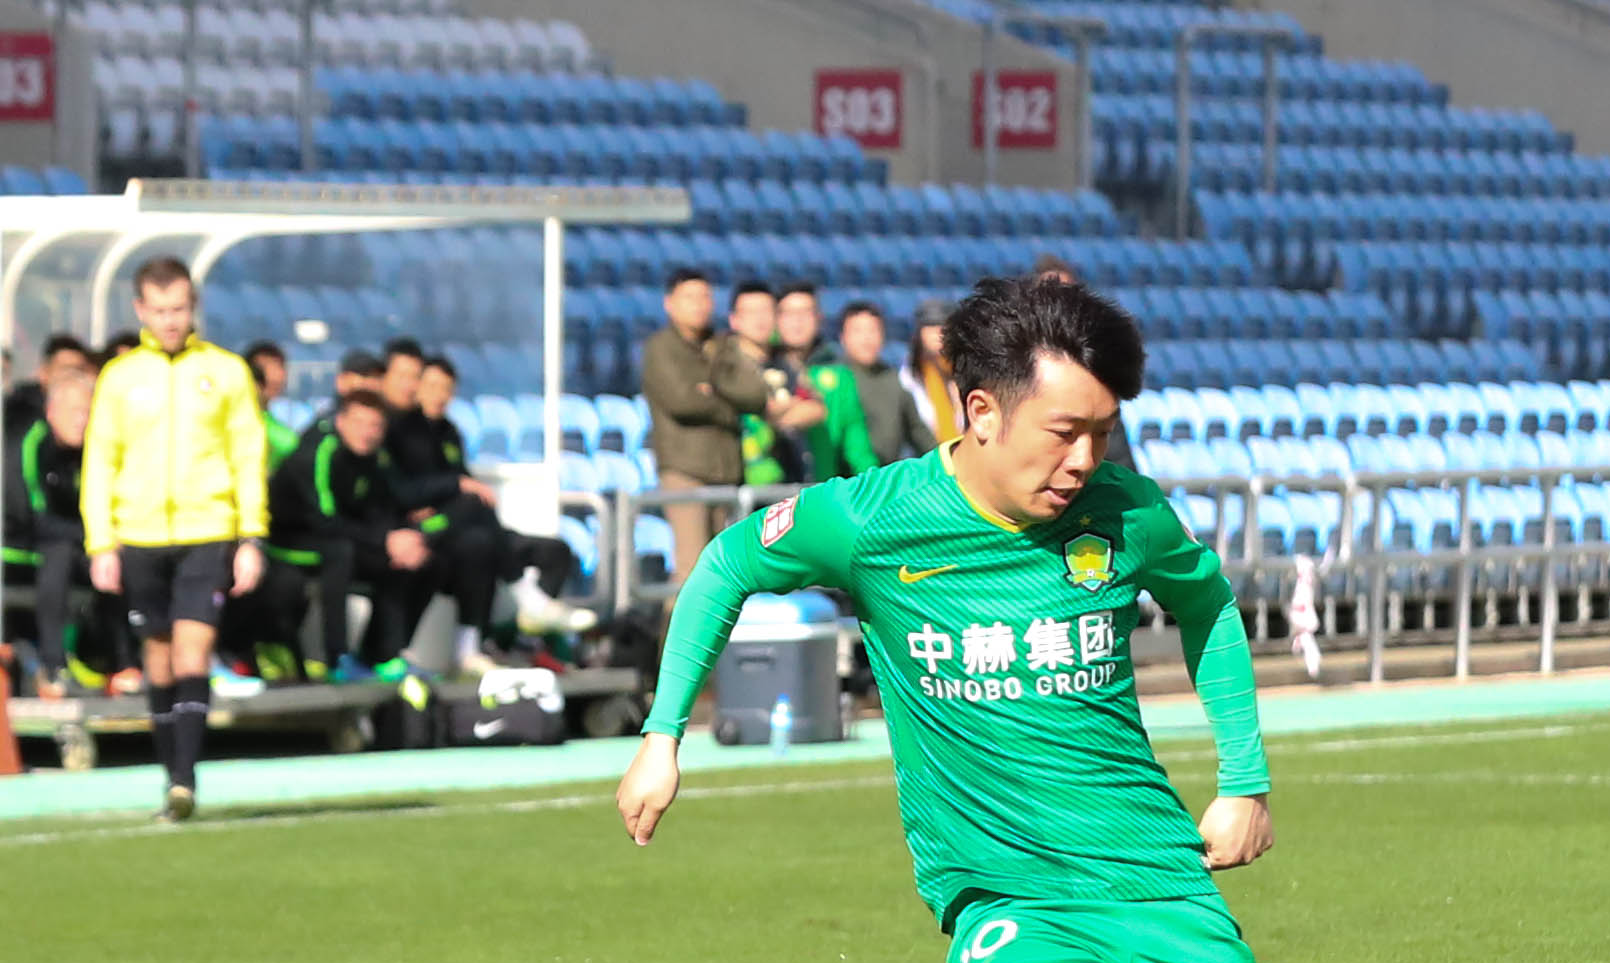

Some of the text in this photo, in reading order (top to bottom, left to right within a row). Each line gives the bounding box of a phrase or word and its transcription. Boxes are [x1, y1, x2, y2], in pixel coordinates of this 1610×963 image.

[822, 86, 896, 137] S03
[907, 611, 1113, 674] 中赫集团
[920, 663, 1116, 702] SINOBO GROUP
